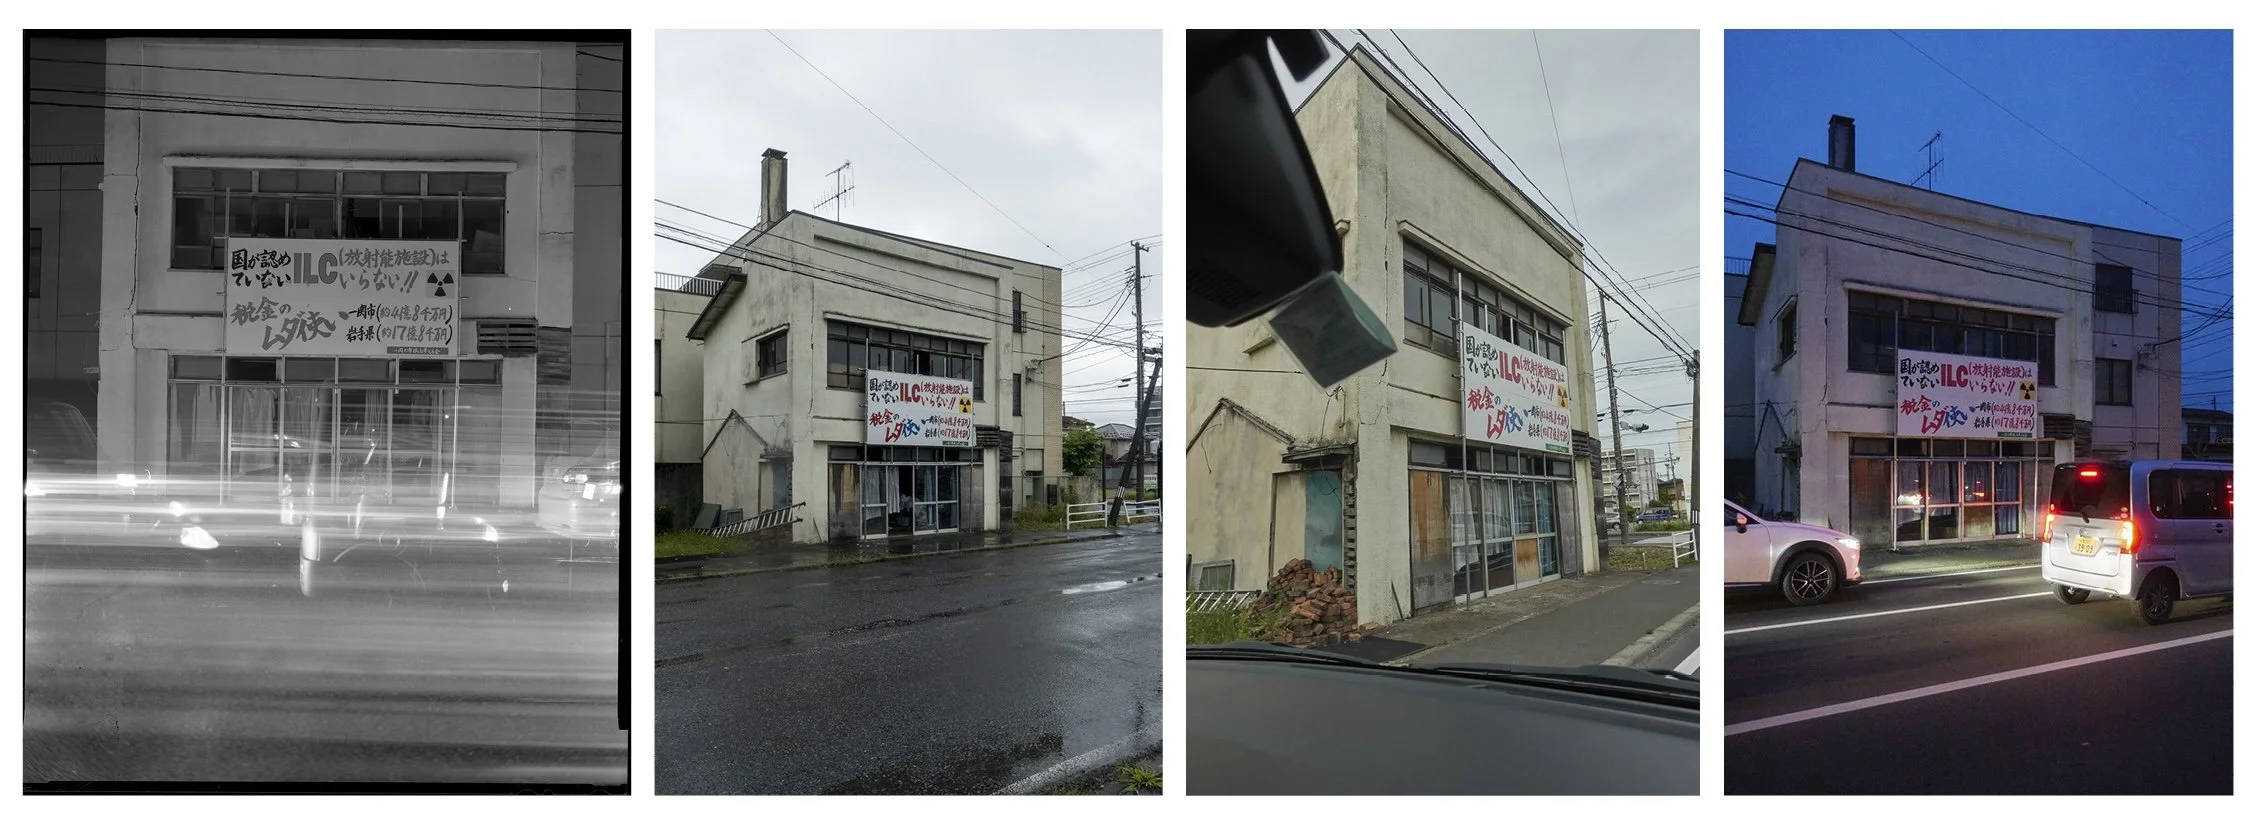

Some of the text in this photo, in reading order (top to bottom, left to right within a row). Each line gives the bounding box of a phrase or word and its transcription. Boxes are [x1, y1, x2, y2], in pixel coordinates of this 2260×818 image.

[232, 248, 292, 270] 国が認め
[293, 252, 338, 284] ILC
[232, 269, 292, 289] ていない
[230, 296, 292, 326] 税金の
[1499, 350, 1521, 384] ILC
[1900, 358, 1940, 375] 国が認め
[1941, 363, 1968, 388] ILC
[900, 382, 920, 403] ILC
[1901, 375, 1940, 389] ていない
[1467, 385, 1501, 412] 税金の
[1900, 394, 1940, 415] 税金の
[869, 408, 900, 427] 税金の
